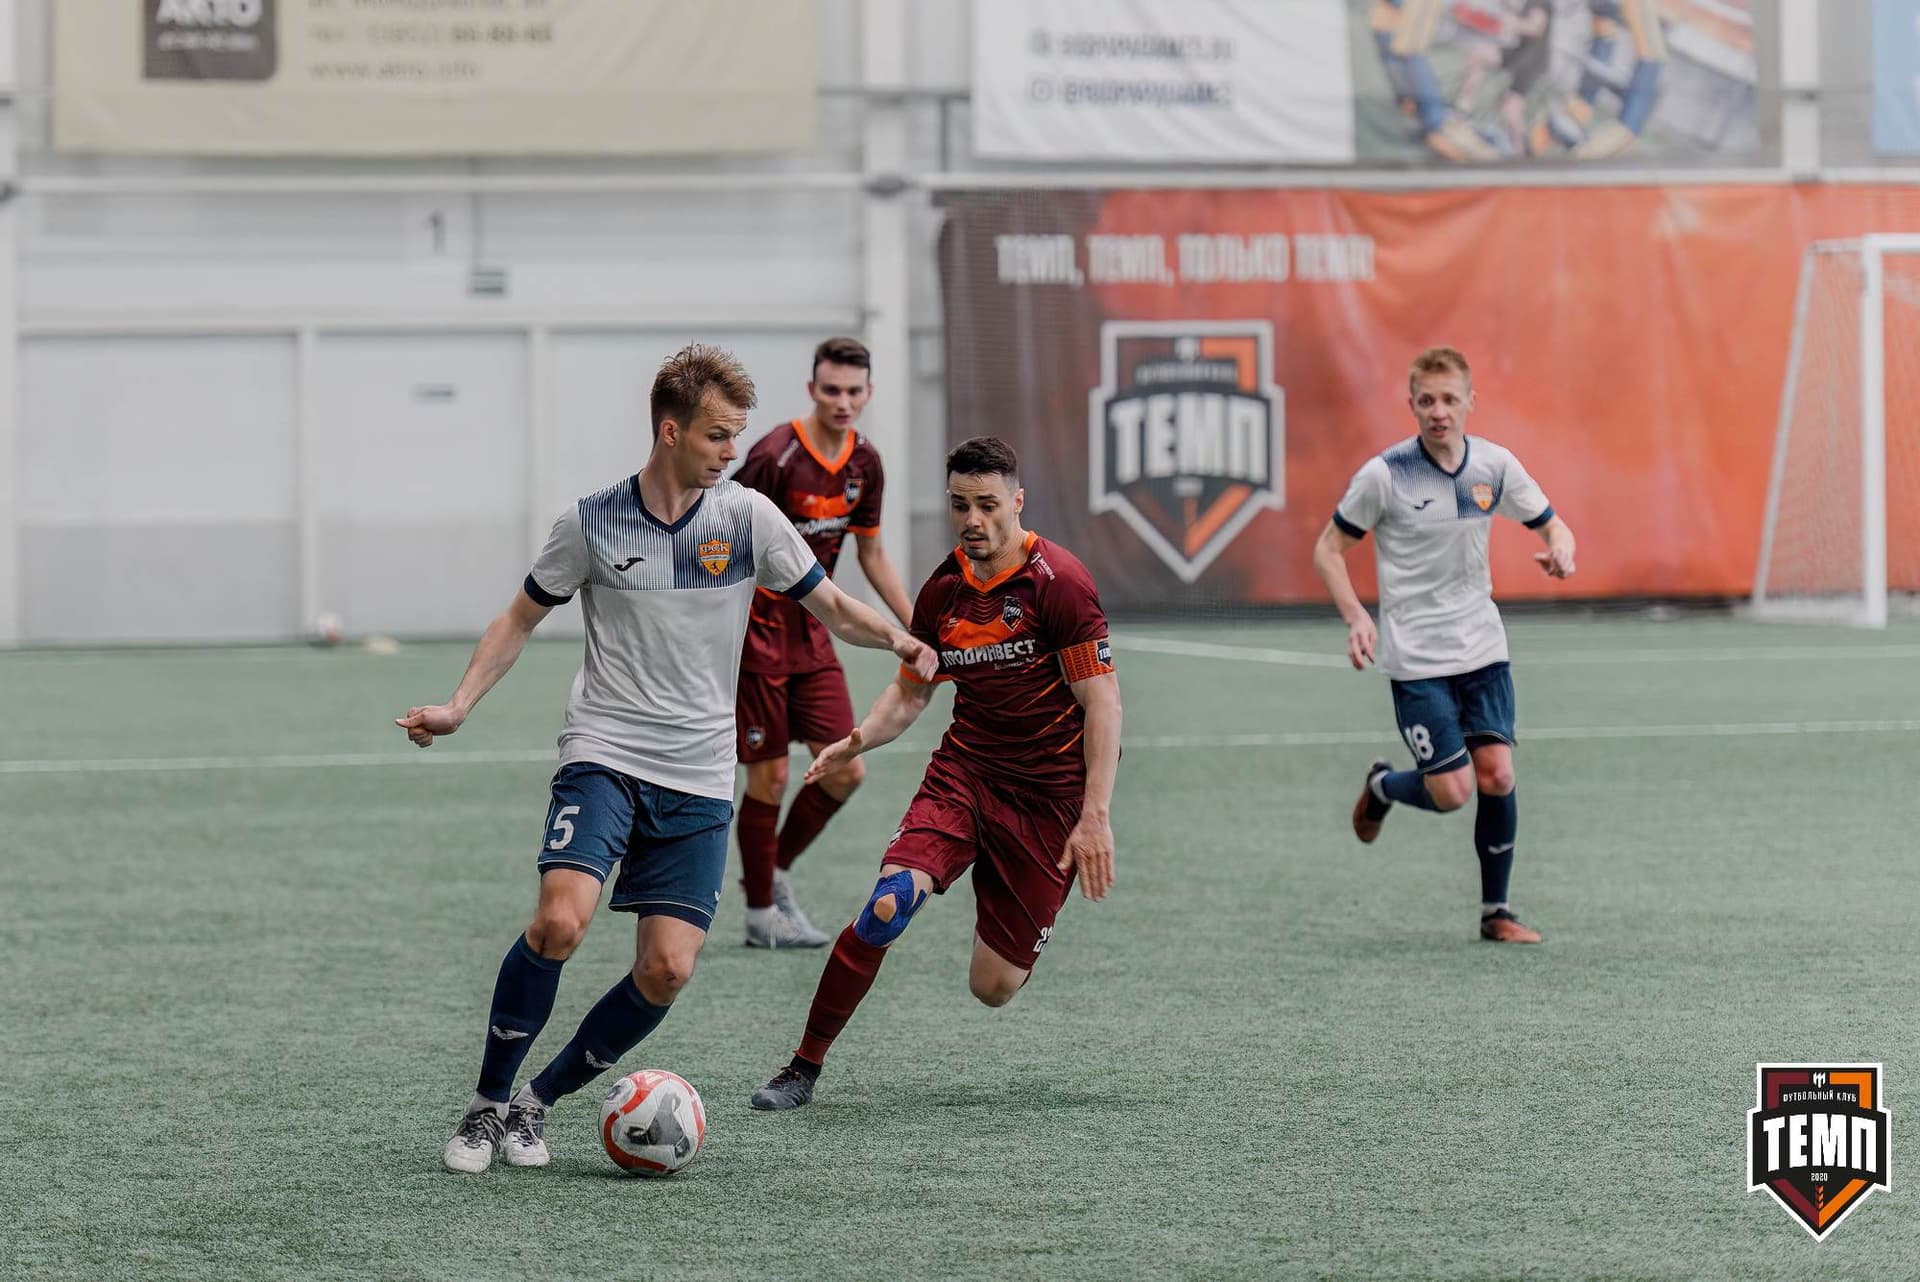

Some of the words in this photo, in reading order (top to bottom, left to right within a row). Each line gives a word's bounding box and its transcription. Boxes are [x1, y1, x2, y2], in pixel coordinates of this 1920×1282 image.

[995, 234, 1085, 287] ТЕМП,
[1087, 234, 1175, 287] ТЕМП,
[1178, 233, 1290, 282] ТОЛЬКО
[1109, 393, 1269, 484] ТЕМП
[1404, 723, 1434, 762] 18
[549, 805, 581, 850] 5
